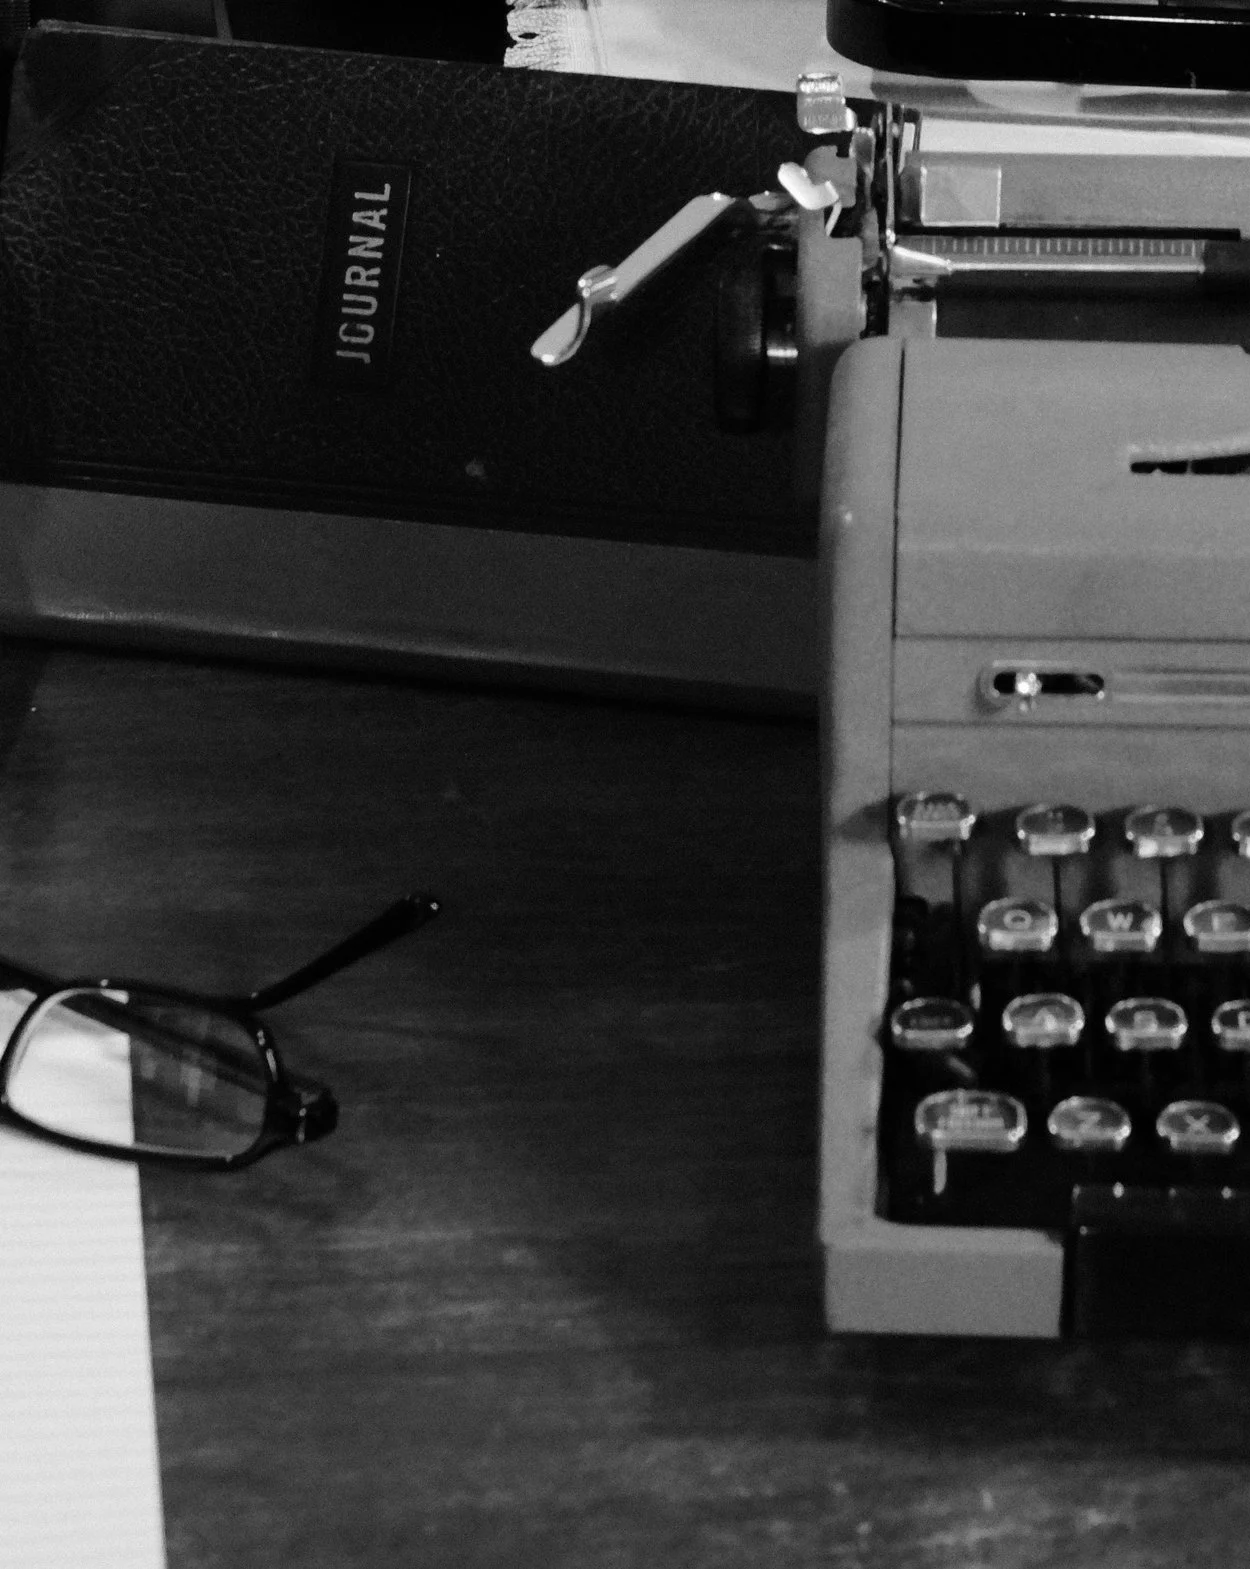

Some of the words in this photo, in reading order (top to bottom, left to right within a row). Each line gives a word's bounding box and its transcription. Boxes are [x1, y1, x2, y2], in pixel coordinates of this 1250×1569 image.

[335, 182, 391, 364] JOURNAL
[1107, 910, 1134, 932] W
[1183, 1113, 1210, 1134] X
